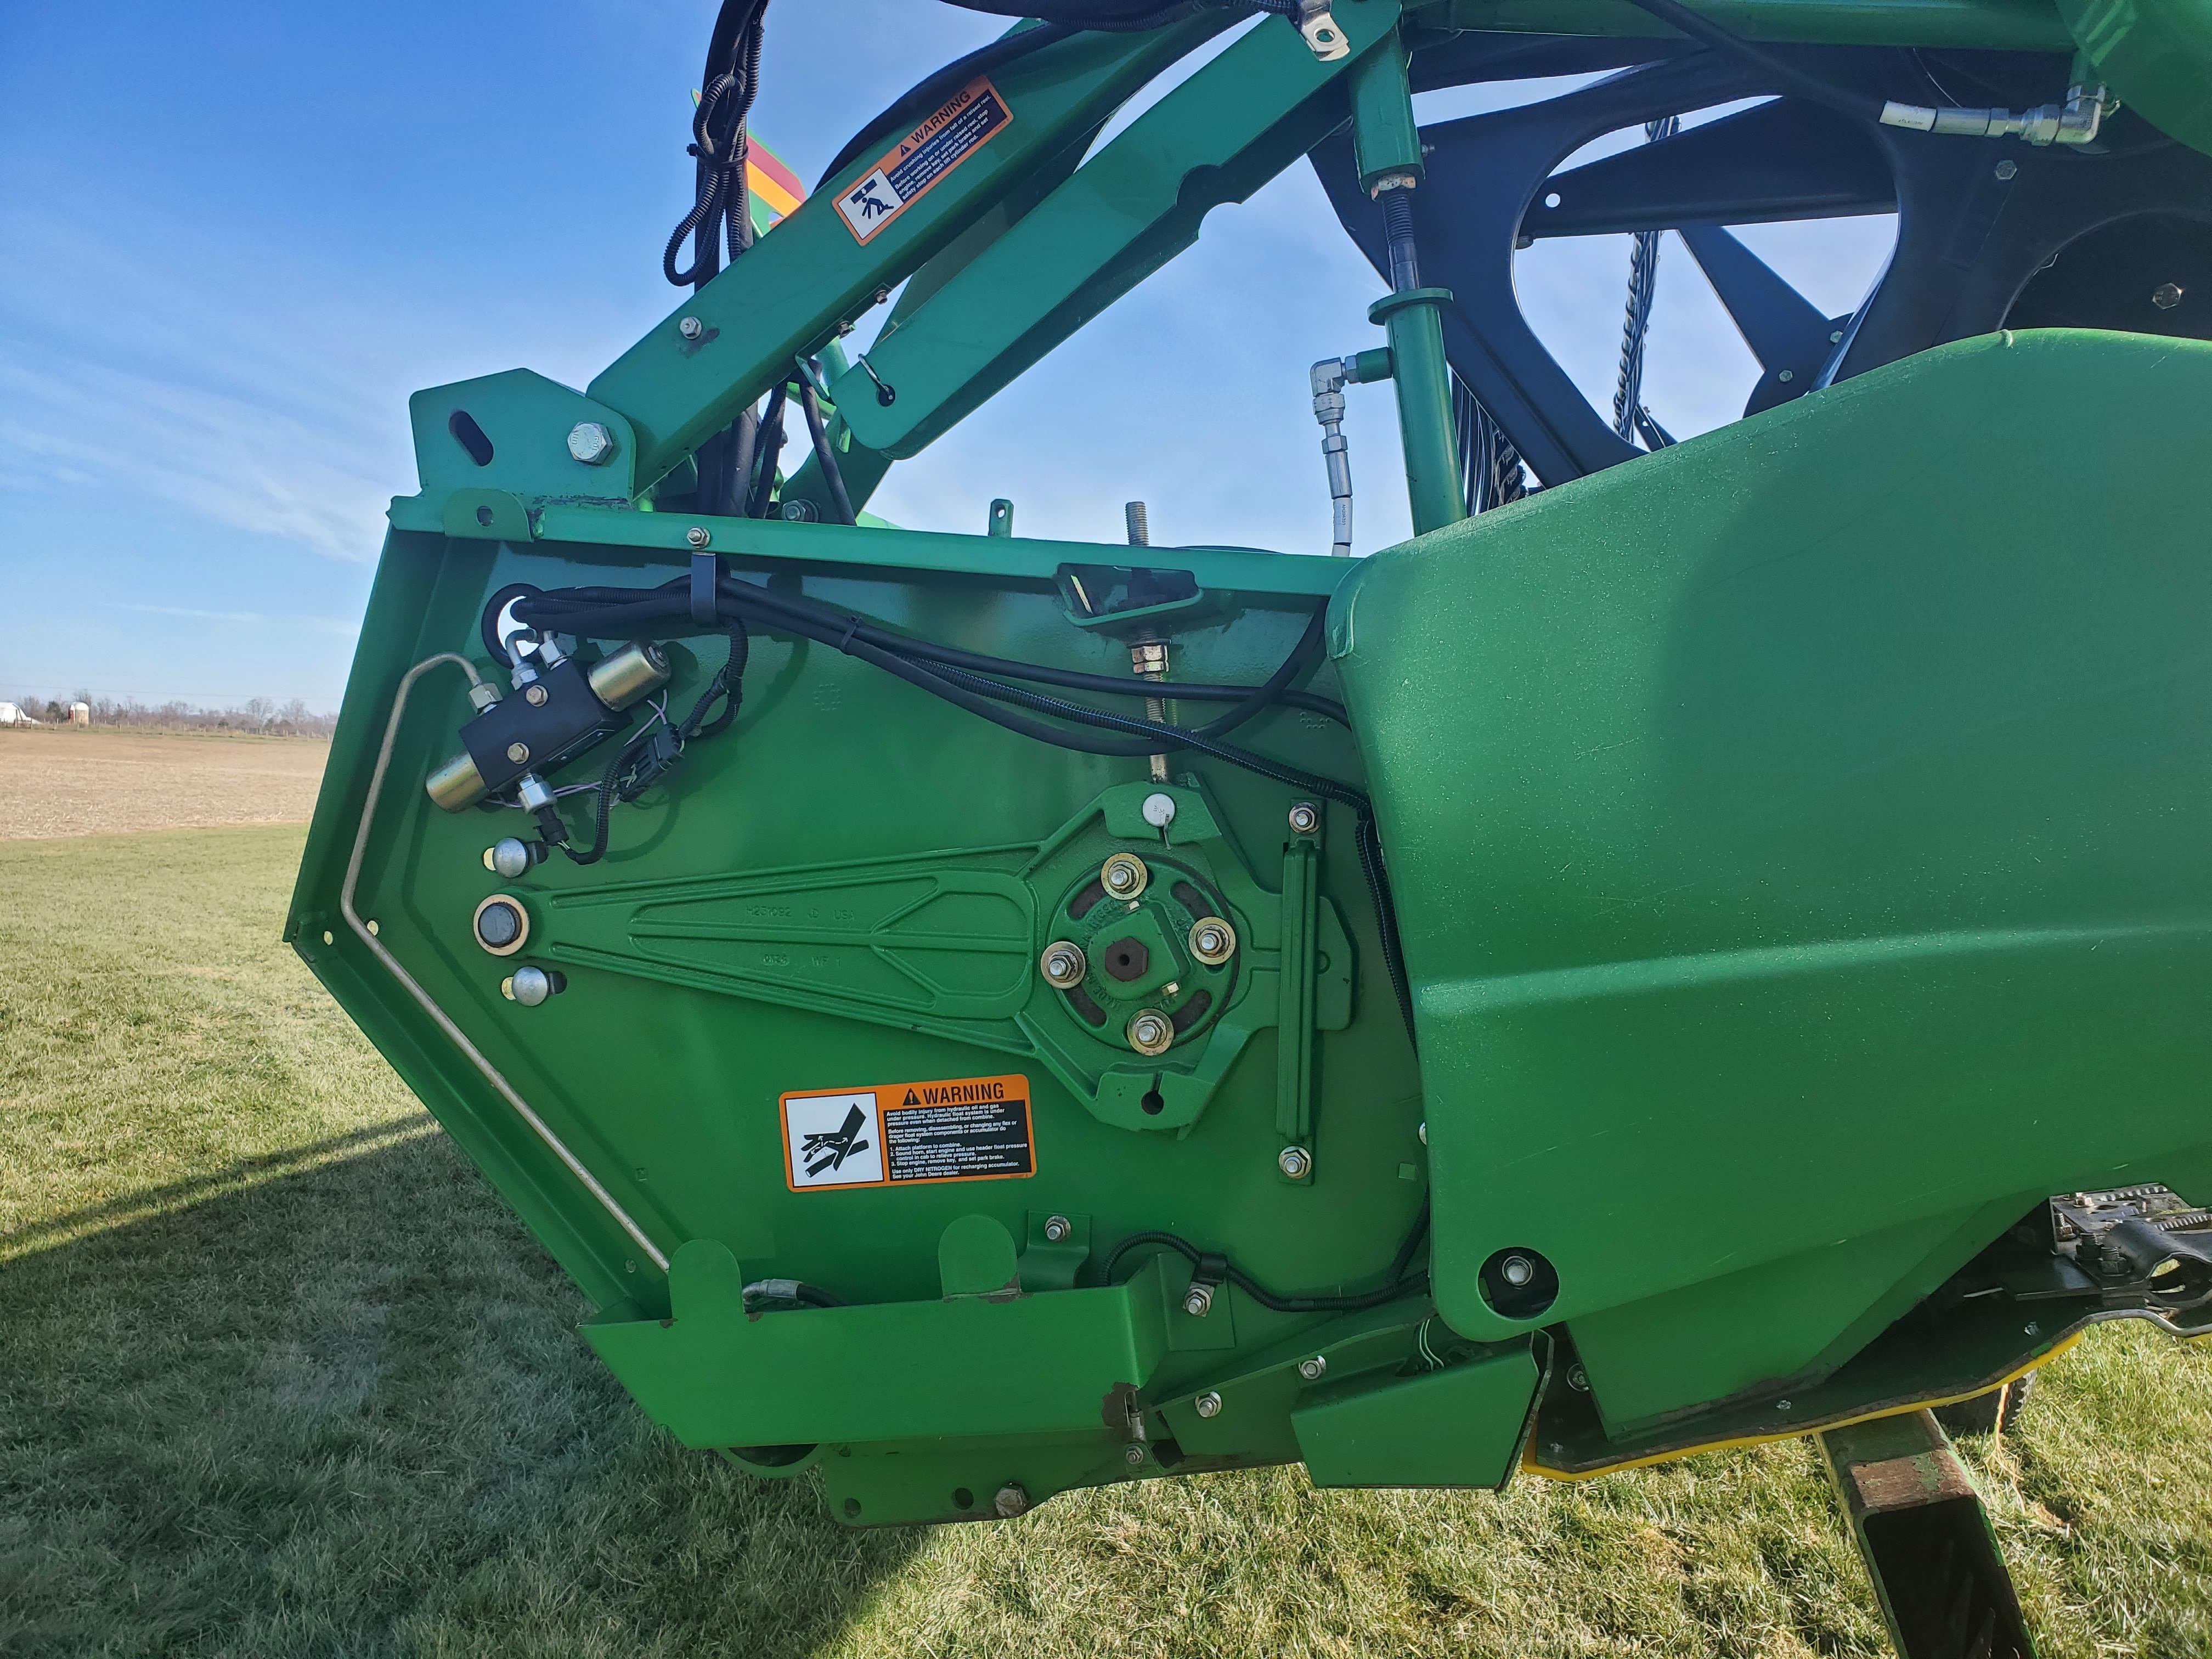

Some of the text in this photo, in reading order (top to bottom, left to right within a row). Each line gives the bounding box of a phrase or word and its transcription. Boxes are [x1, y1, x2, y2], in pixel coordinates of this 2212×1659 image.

[890, 169, 903, 182] Avoid
[903, 153, 923, 171] crushing
[922, 139, 939, 154] injuries
[939, 129, 950, 140] from
[967, 103, 981, 117] raised
[980, 95, 991, 106] reel.
[895, 176, 910, 189] Before
[910, 160, 929, 177] working
[940, 139, 953, 151] under
[953, 126, 968, 140] raised
[967, 118, 978, 128] reel,
[977, 109, 988, 120] stop
[911, 91, 970, 143] WARNING
[899, 180, 916, 195] engine,
[915, 166, 932, 180] remove
[931, 158, 941, 167] key,
[948, 143, 960, 154] park
[958, 131, 972, 144] brake
[971, 123, 981, 133] and
[902, 187, 916, 200] safety
[916, 178, 927, 188] stop
[933, 163, 944, 174] each
[950, 142, 969, 159] cylinder
[969, 134, 978, 144] rod.
[833, 910, 855, 920] USA
[923, 1083, 1004, 1104] WARNING
